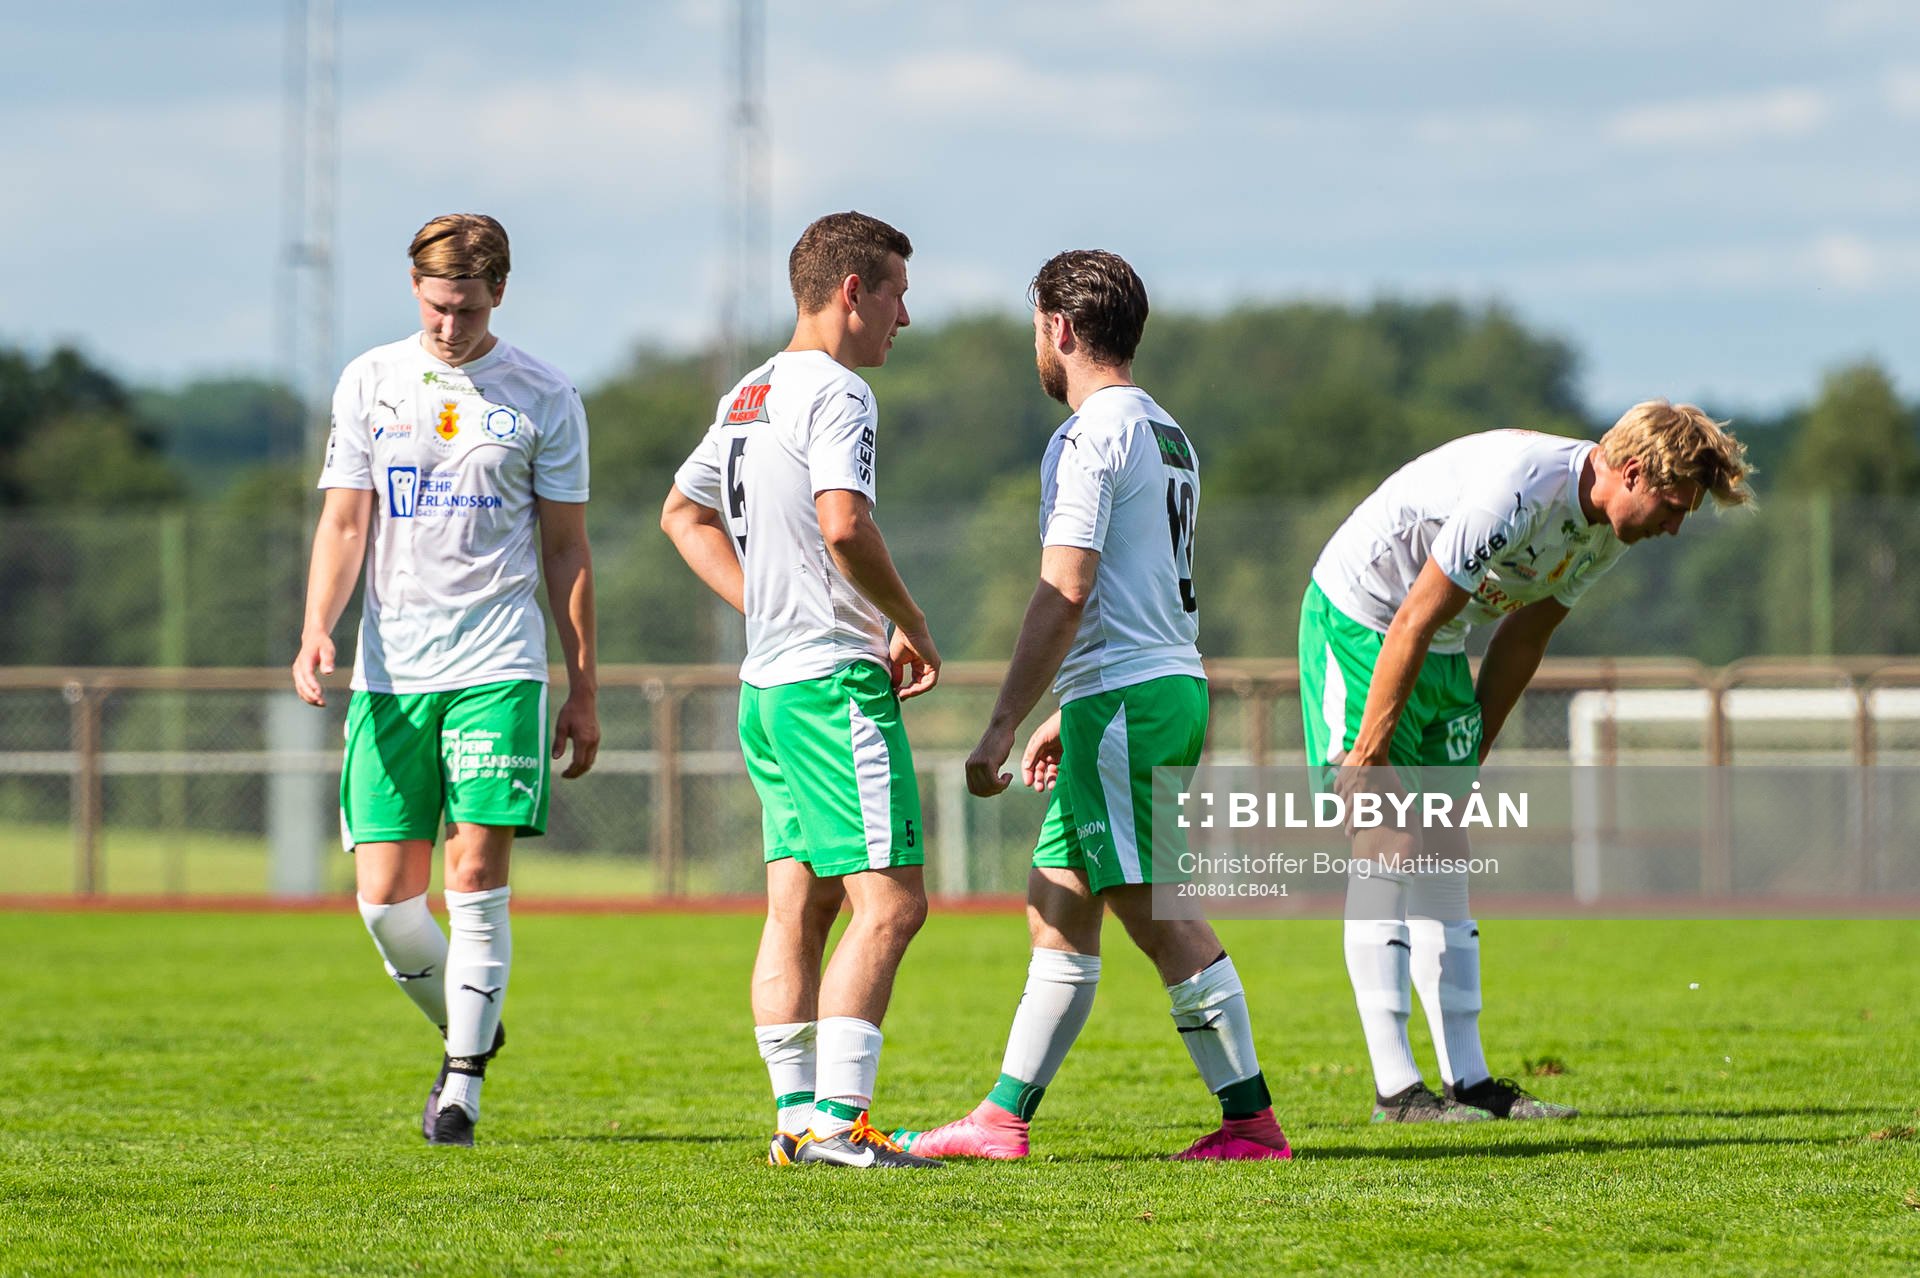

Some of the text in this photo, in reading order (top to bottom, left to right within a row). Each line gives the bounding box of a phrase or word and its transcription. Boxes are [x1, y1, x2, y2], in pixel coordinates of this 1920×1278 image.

[859, 426, 874, 485] SEB
[420, 480, 453, 492] PEHR
[417, 495, 503, 508] ERLANDSSON
[1464, 533, 1508, 576] SEB
[905, 820, 915, 848] 5
